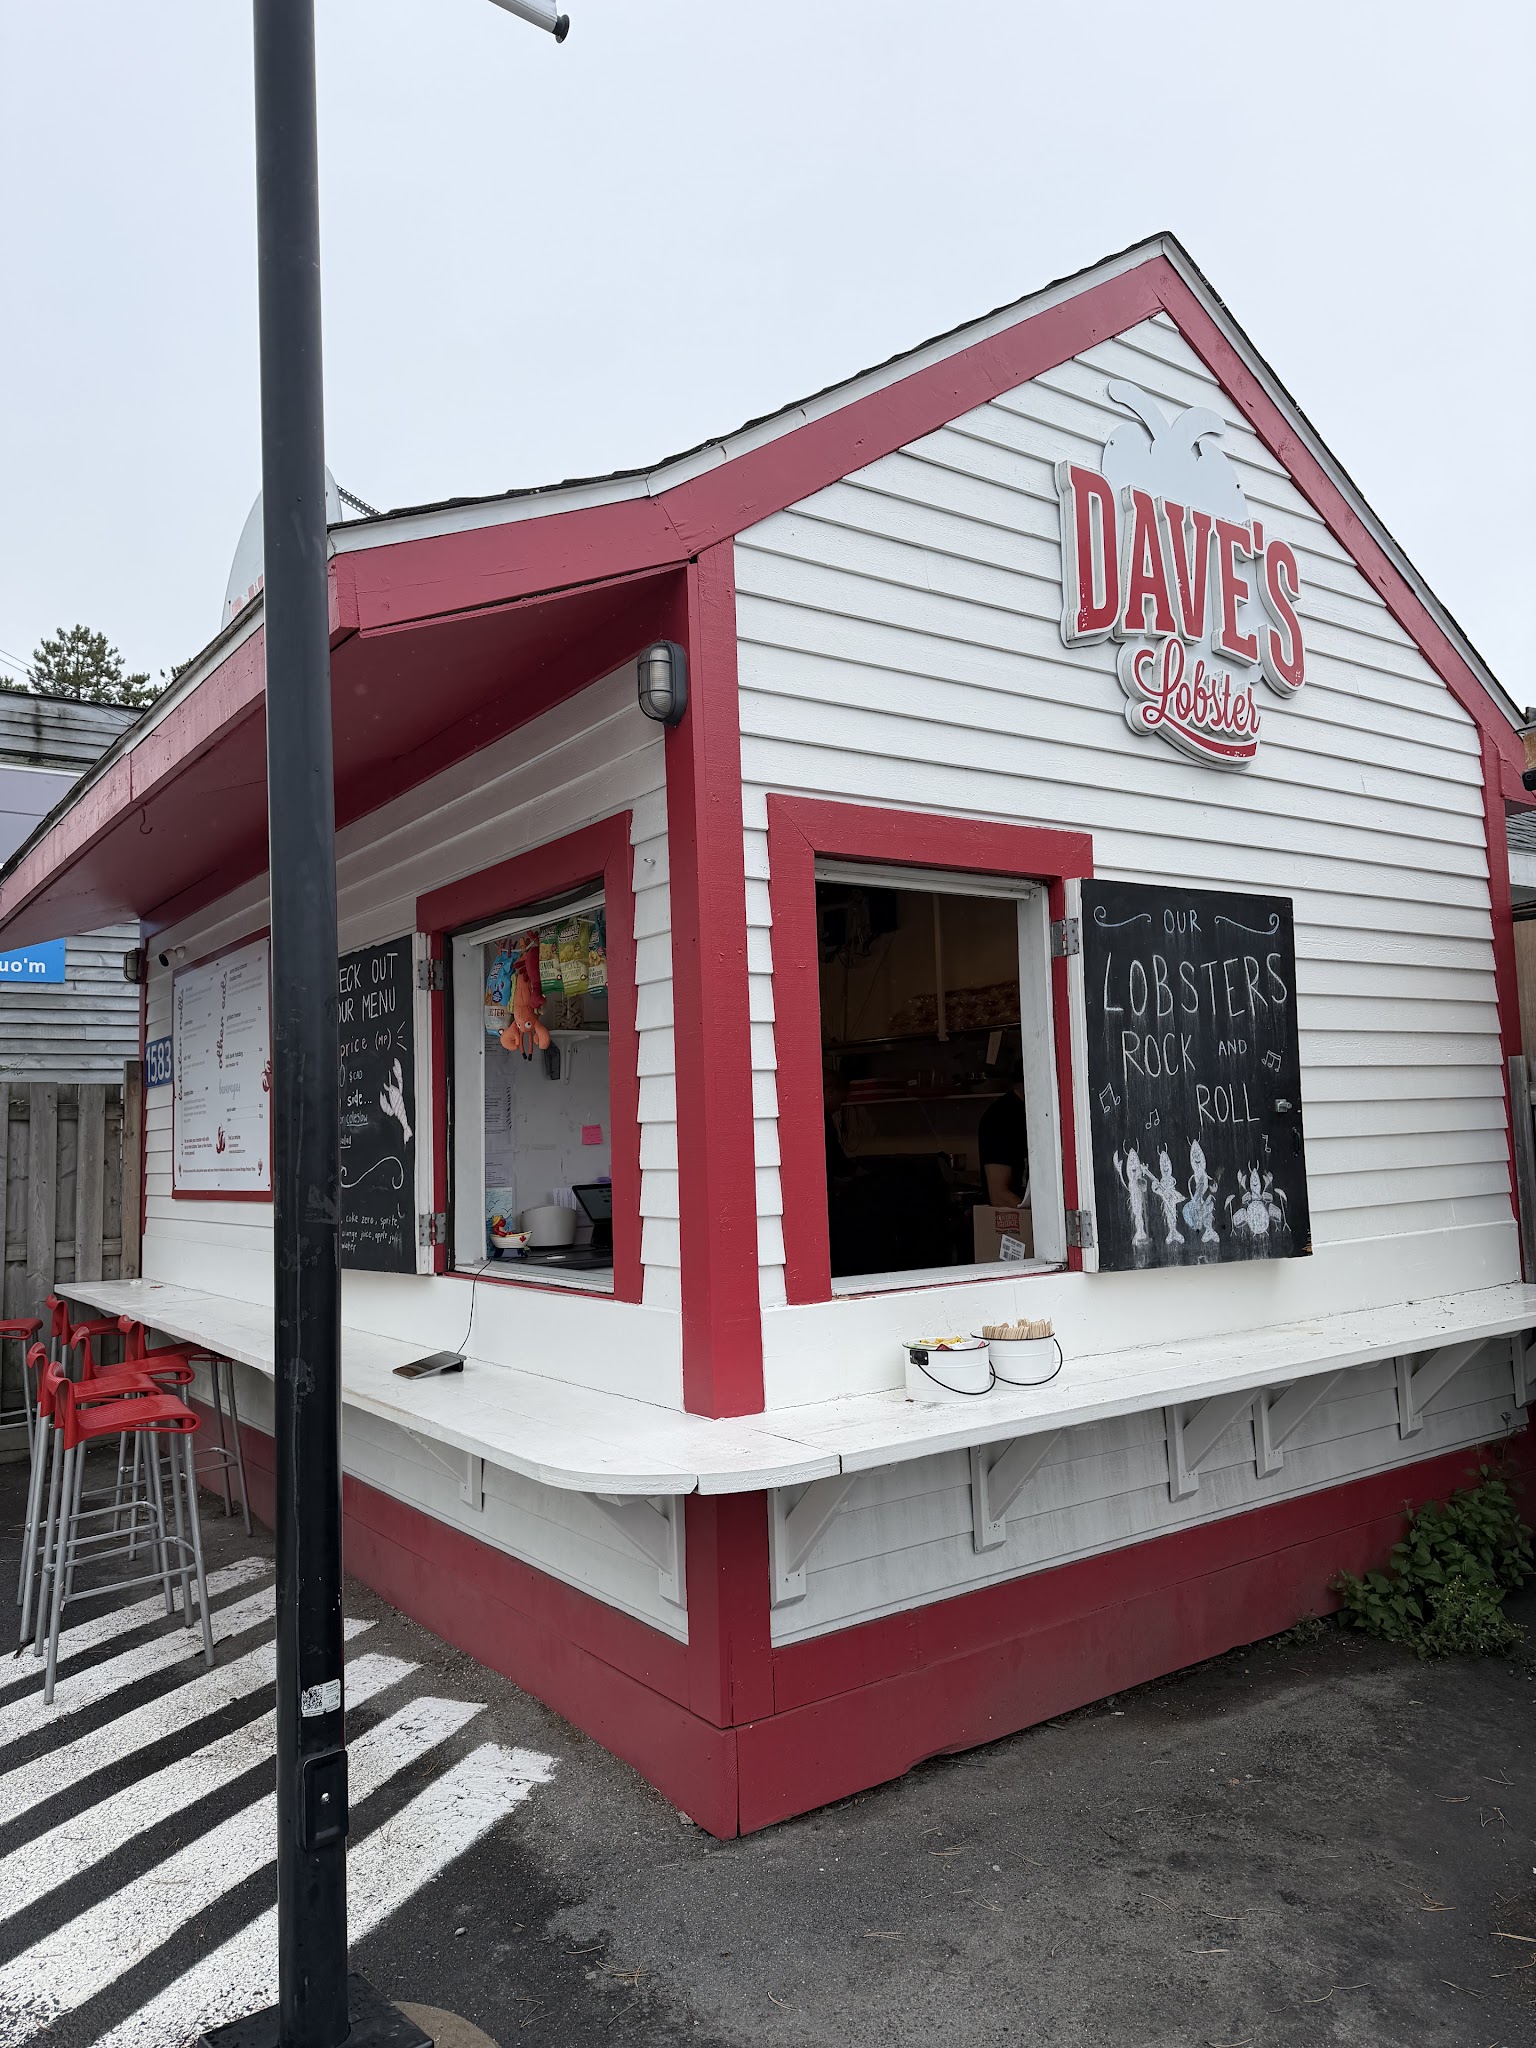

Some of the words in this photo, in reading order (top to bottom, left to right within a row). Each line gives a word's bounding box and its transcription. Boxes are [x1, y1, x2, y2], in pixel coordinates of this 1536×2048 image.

[1070, 466, 1304, 688] DAVE'S
[1134, 638, 1262, 734] Lobster
[1163, 908, 1202, 933] OUR
[339, 963, 362, 993] ECK
[371, 952, 399, 984] OUT
[1103, 952, 1289, 1018] LOBSTERS
[362, 986, 396, 1022] MENU
[146, 1040, 171, 1083] 1583
[340, 1035, 367, 1067] price
[375, 1027, 392, 1051] (MP)
[1120, 1029, 1197, 1080] ROCK
[1217, 1038, 1248, 1057] AND
[1196, 1083, 1260, 1126] ROLL
[345, 1211, 359, 1223] coke
